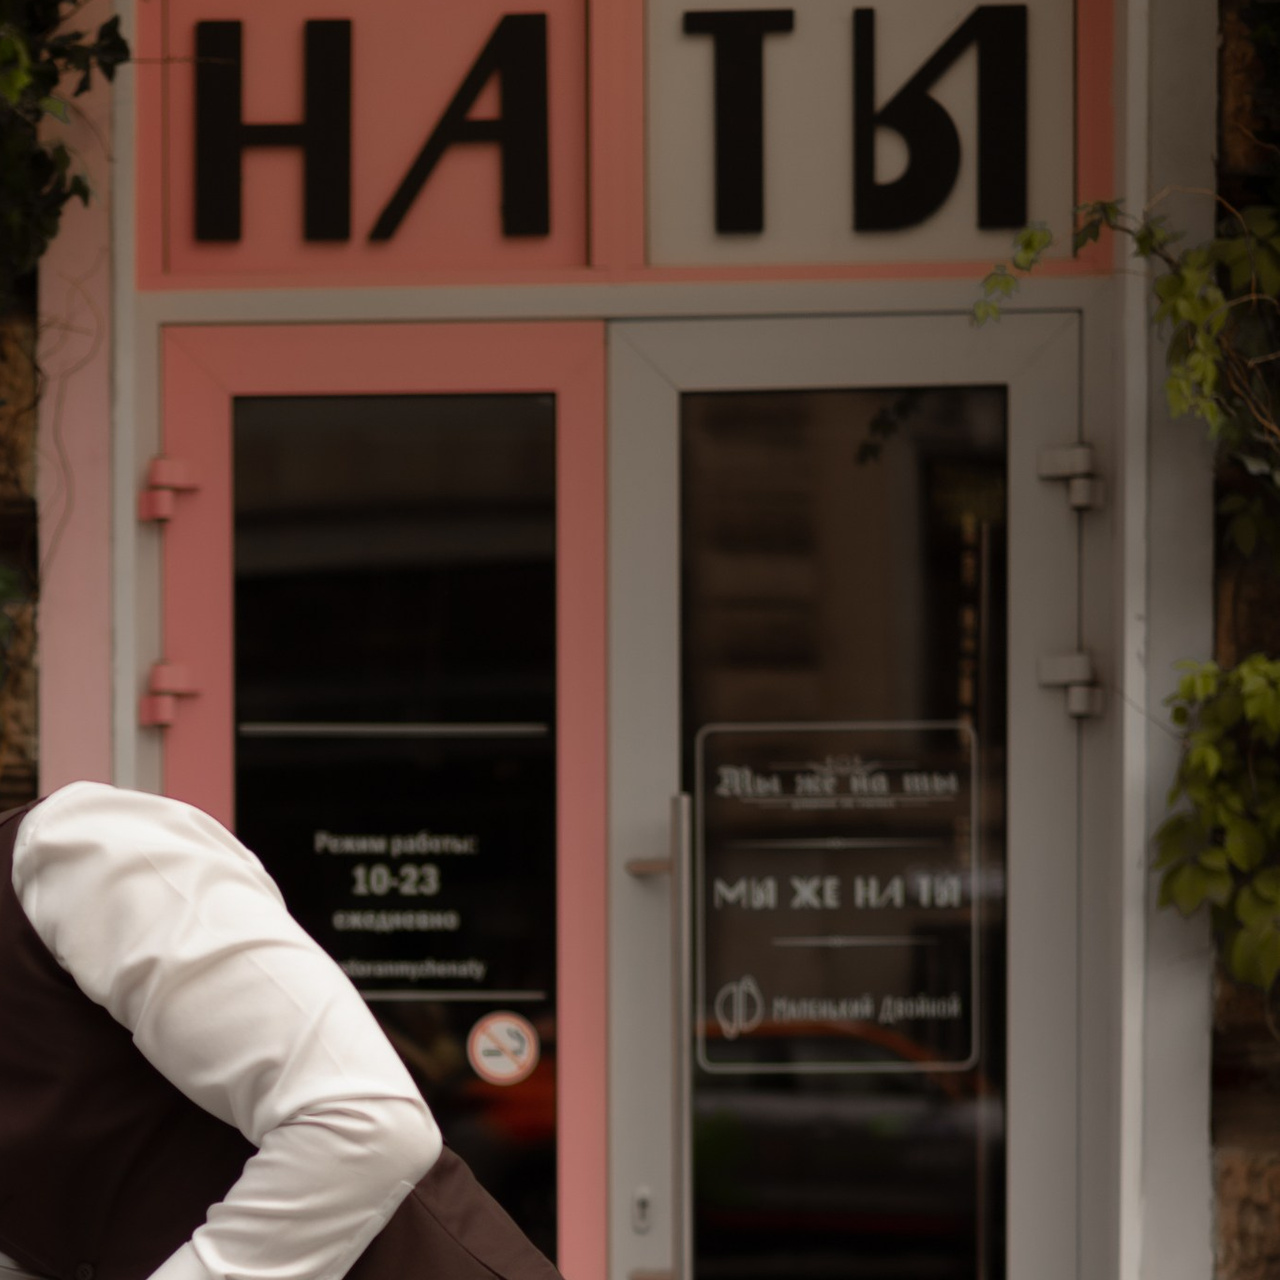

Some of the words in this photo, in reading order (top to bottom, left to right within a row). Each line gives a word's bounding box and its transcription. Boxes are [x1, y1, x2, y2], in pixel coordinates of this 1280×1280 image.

[193, 12, 551, 244] НА
[315, 831, 387, 855] Режим
[392, 832, 475, 858] работы:
[351, 864, 441, 896] 10-23
[791, 877, 841, 908] ЖЕ
[854, 875, 904, 909] НА
[333, 912, 458, 932] ежедневно
